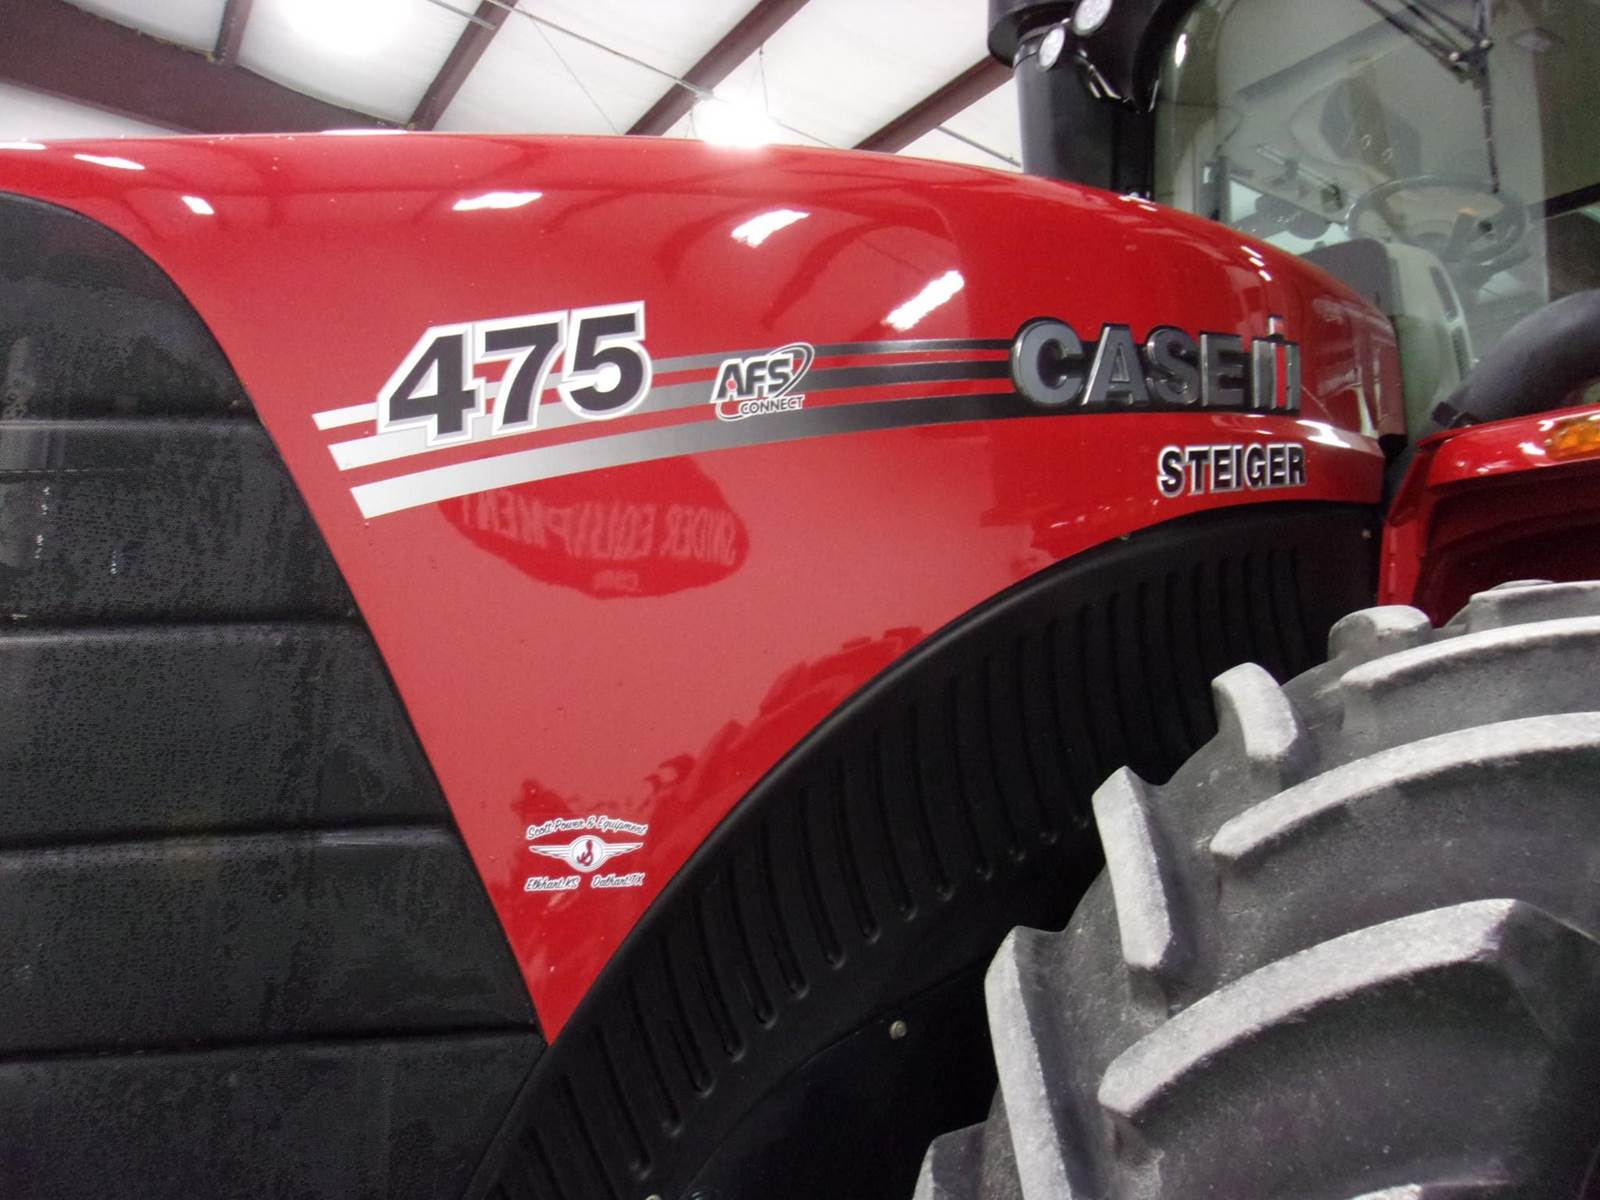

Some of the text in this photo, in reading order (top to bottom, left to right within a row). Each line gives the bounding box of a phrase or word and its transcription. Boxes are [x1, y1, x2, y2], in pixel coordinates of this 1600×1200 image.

[378, 301, 651, 446] 475
[711, 353, 794, 402] AFS
[1010, 316, 1245, 410] CASE
[739, 395, 805, 414] CONNECT
[1157, 444, 1306, 497] STEIGER
[527, 815, 648, 839] Scott Power & Equipment
